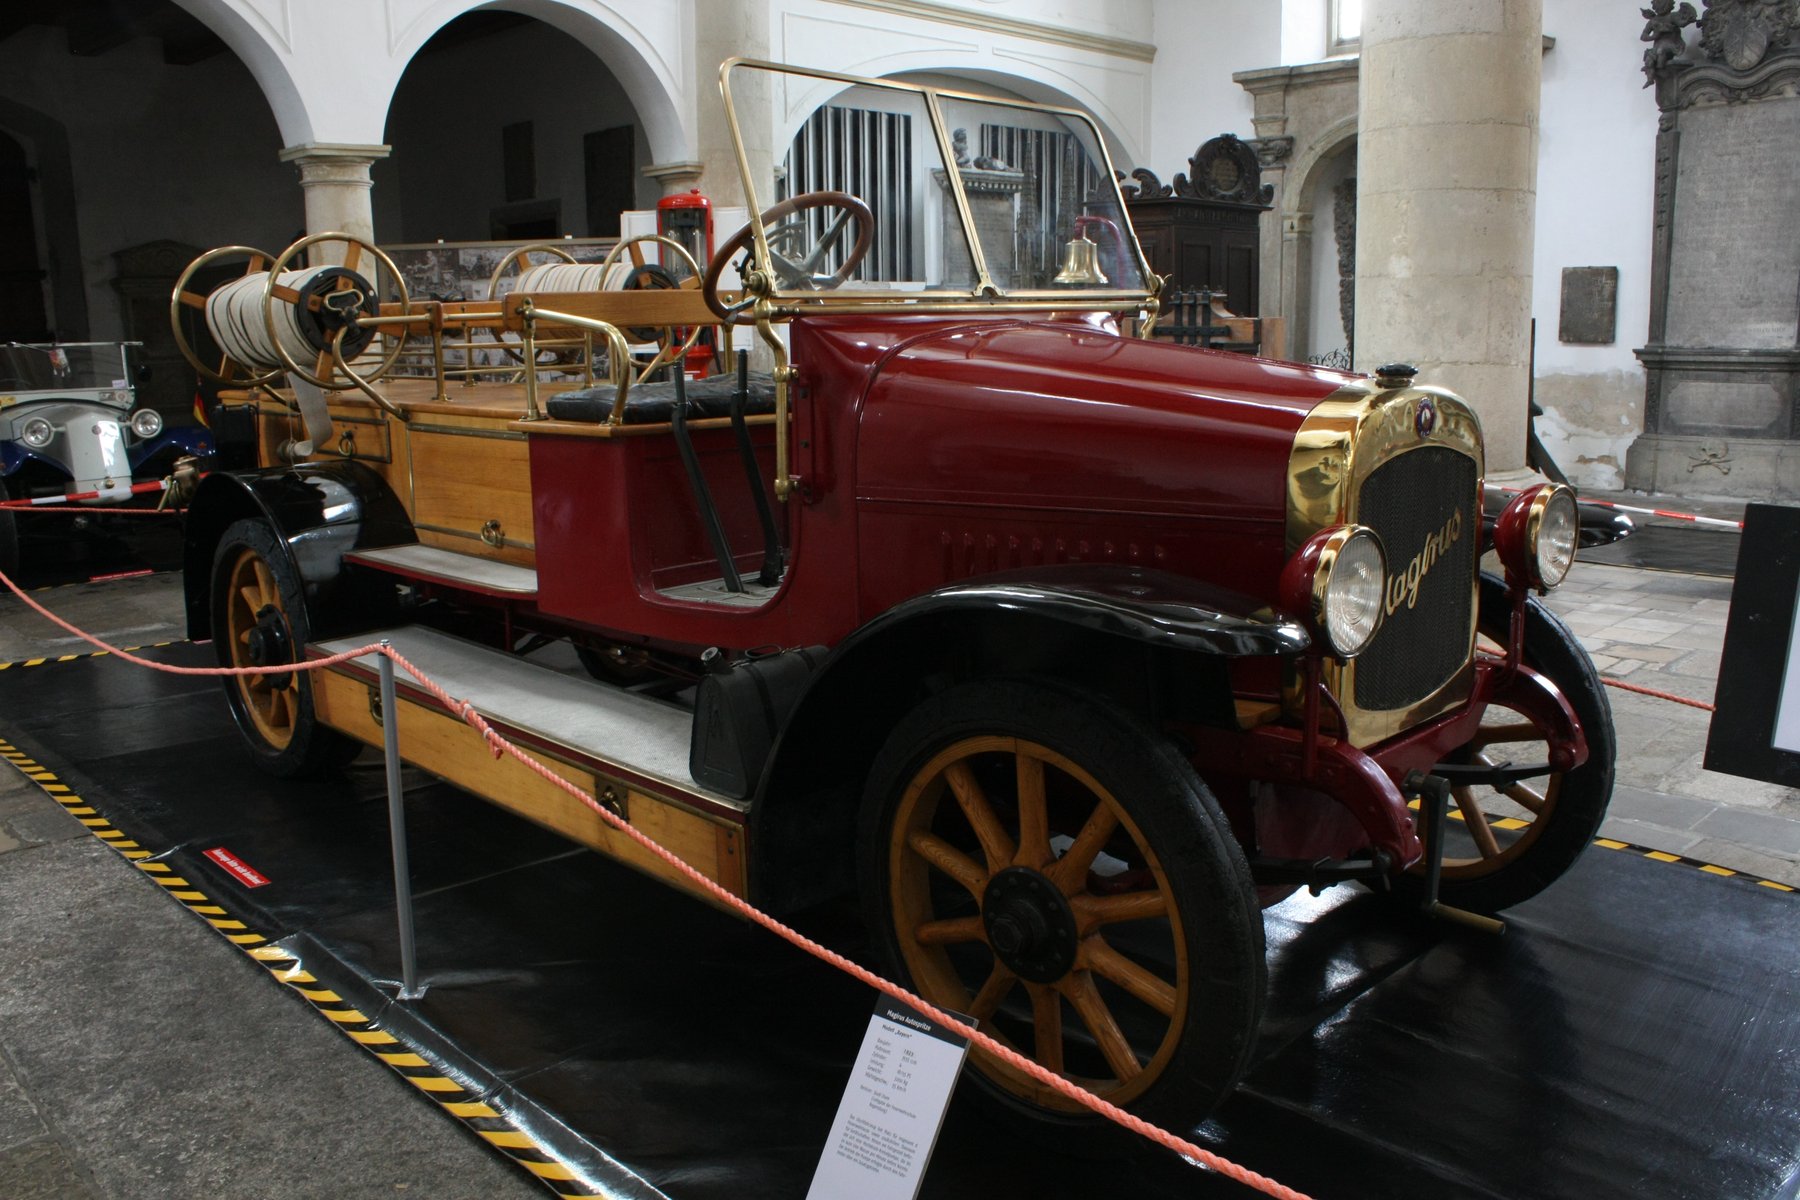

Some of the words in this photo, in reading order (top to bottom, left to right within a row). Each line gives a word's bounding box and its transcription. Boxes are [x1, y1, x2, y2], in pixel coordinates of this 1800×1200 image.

[1386, 507, 1461, 616] agirus
[887, 1009, 905, 1022] Magirus
[905, 1016, 932, 1032] Autospritze
